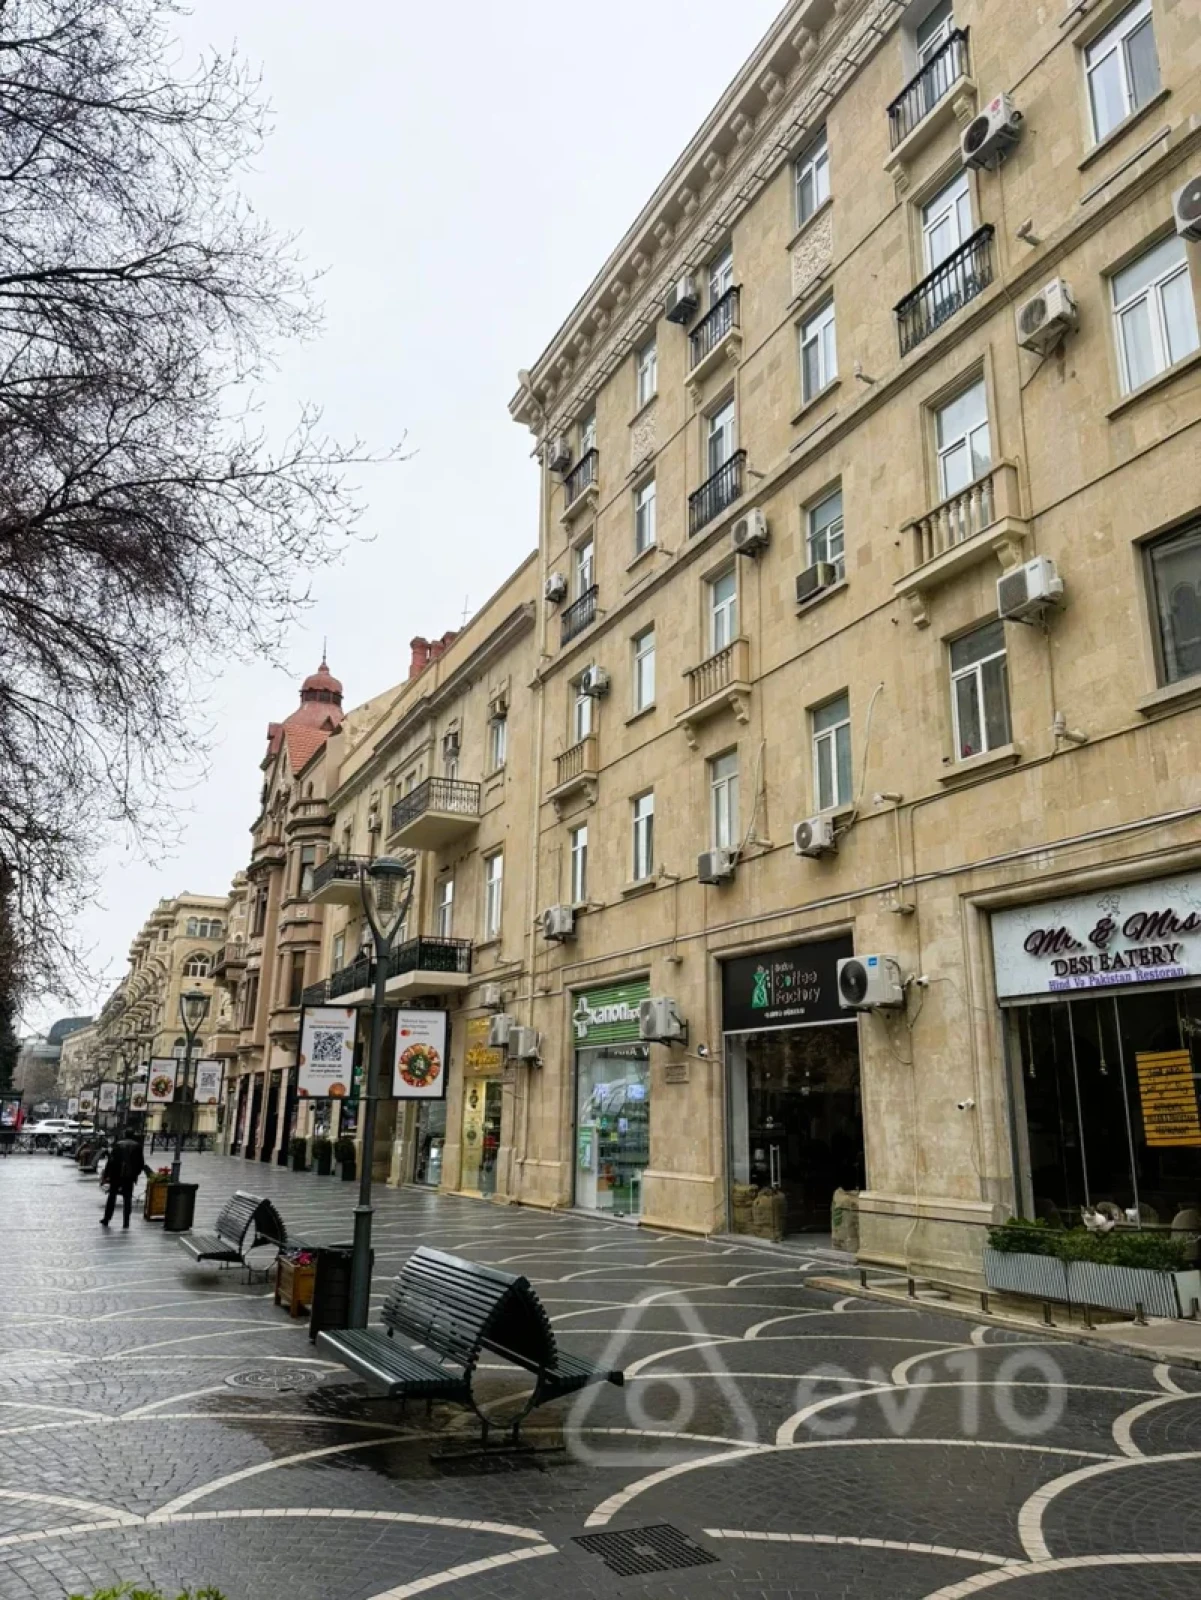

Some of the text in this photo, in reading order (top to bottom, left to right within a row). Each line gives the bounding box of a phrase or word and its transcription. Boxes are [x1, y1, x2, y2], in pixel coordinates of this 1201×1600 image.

[1023, 926, 1083, 956] Mr.
[1088, 913, 1116, 949] &
[1050, 943, 1180, 977] DESI EATERY
[775, 970, 818, 989] Coffee
[1089, 972, 1132, 987] Pakistan
[1135, 967, 1184, 981] Restoran
[775, 986, 821, 1005] Factory
